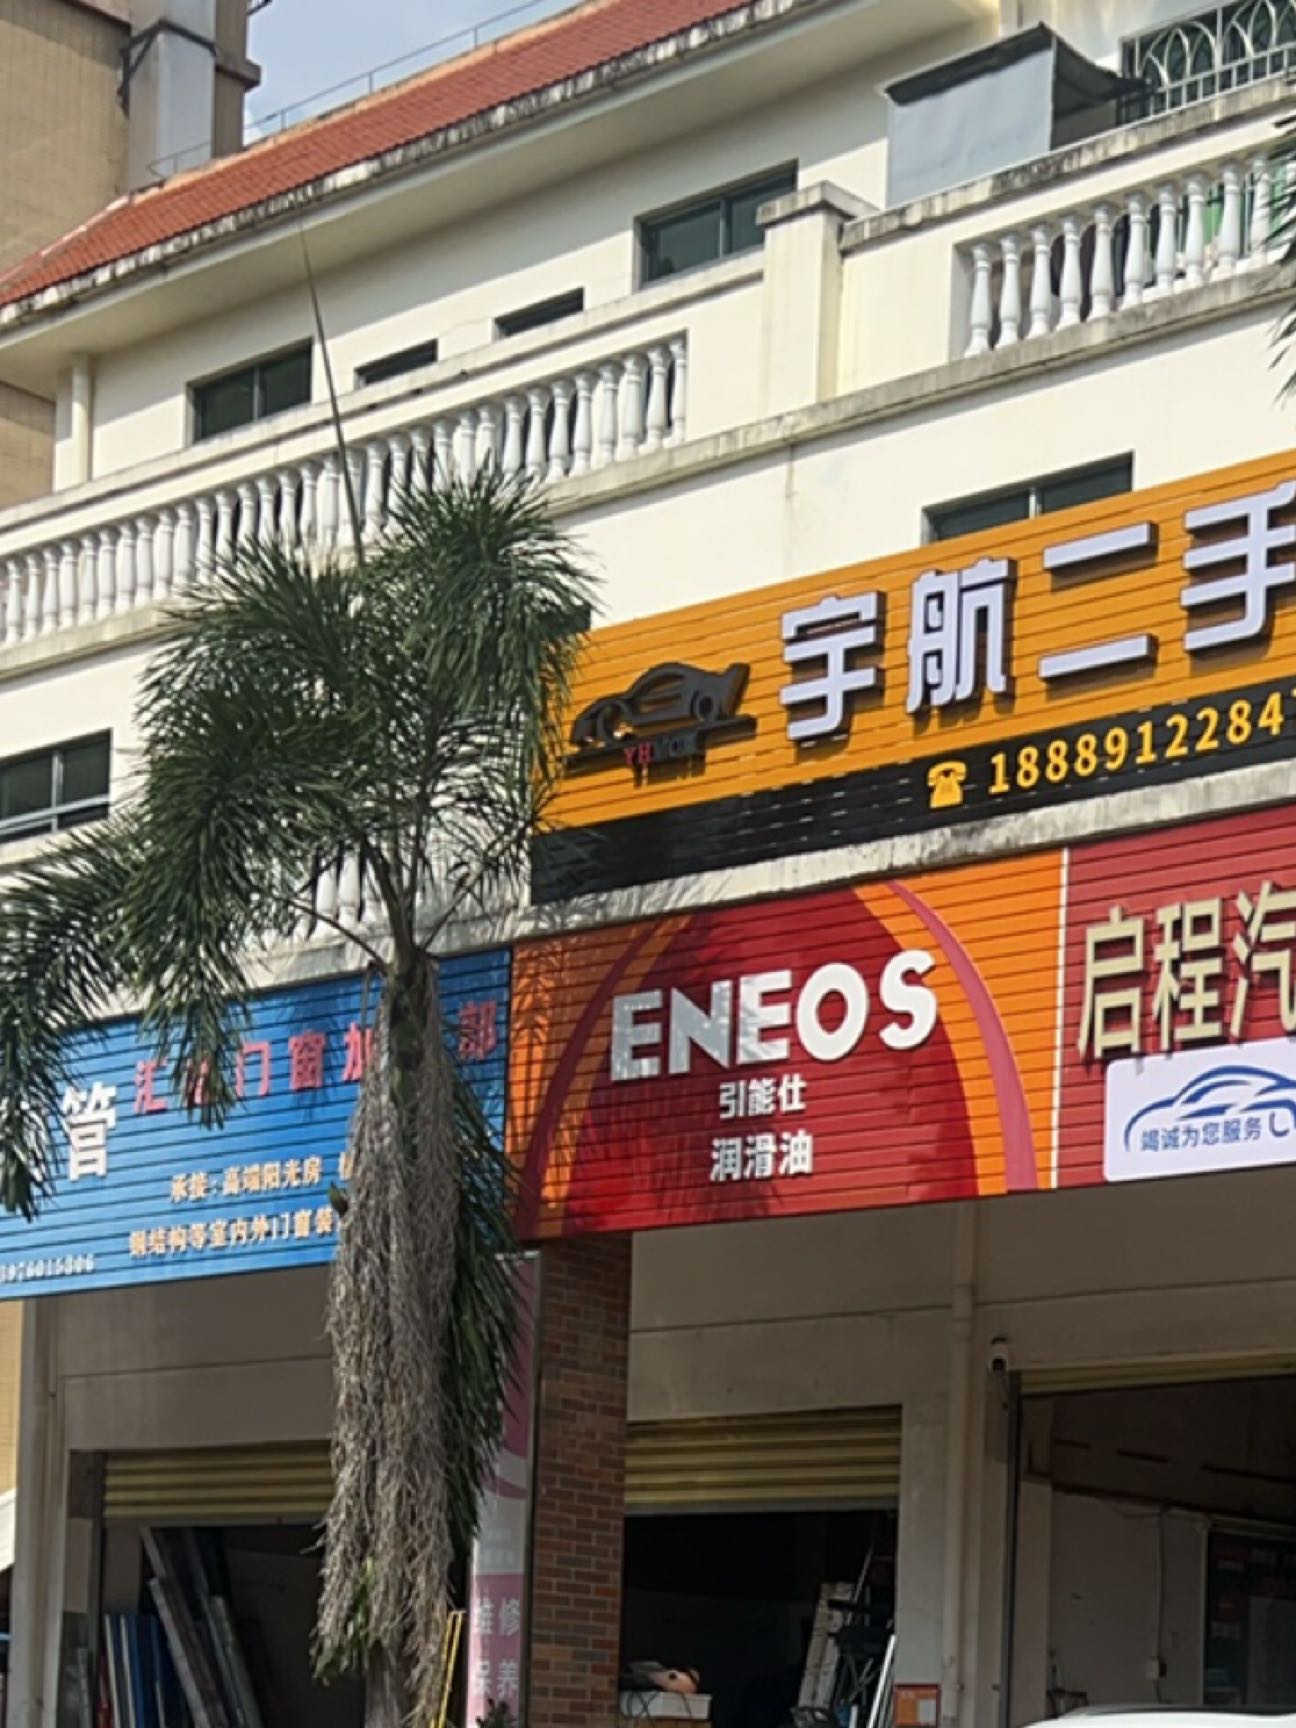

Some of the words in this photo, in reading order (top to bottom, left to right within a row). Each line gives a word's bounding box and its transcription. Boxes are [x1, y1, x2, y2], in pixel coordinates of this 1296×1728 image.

[610, 947, 938, 1082] ENEOS
[718, 1074, 807, 1120] 引能仕
[710, 1130, 814, 1182] 润滑油
